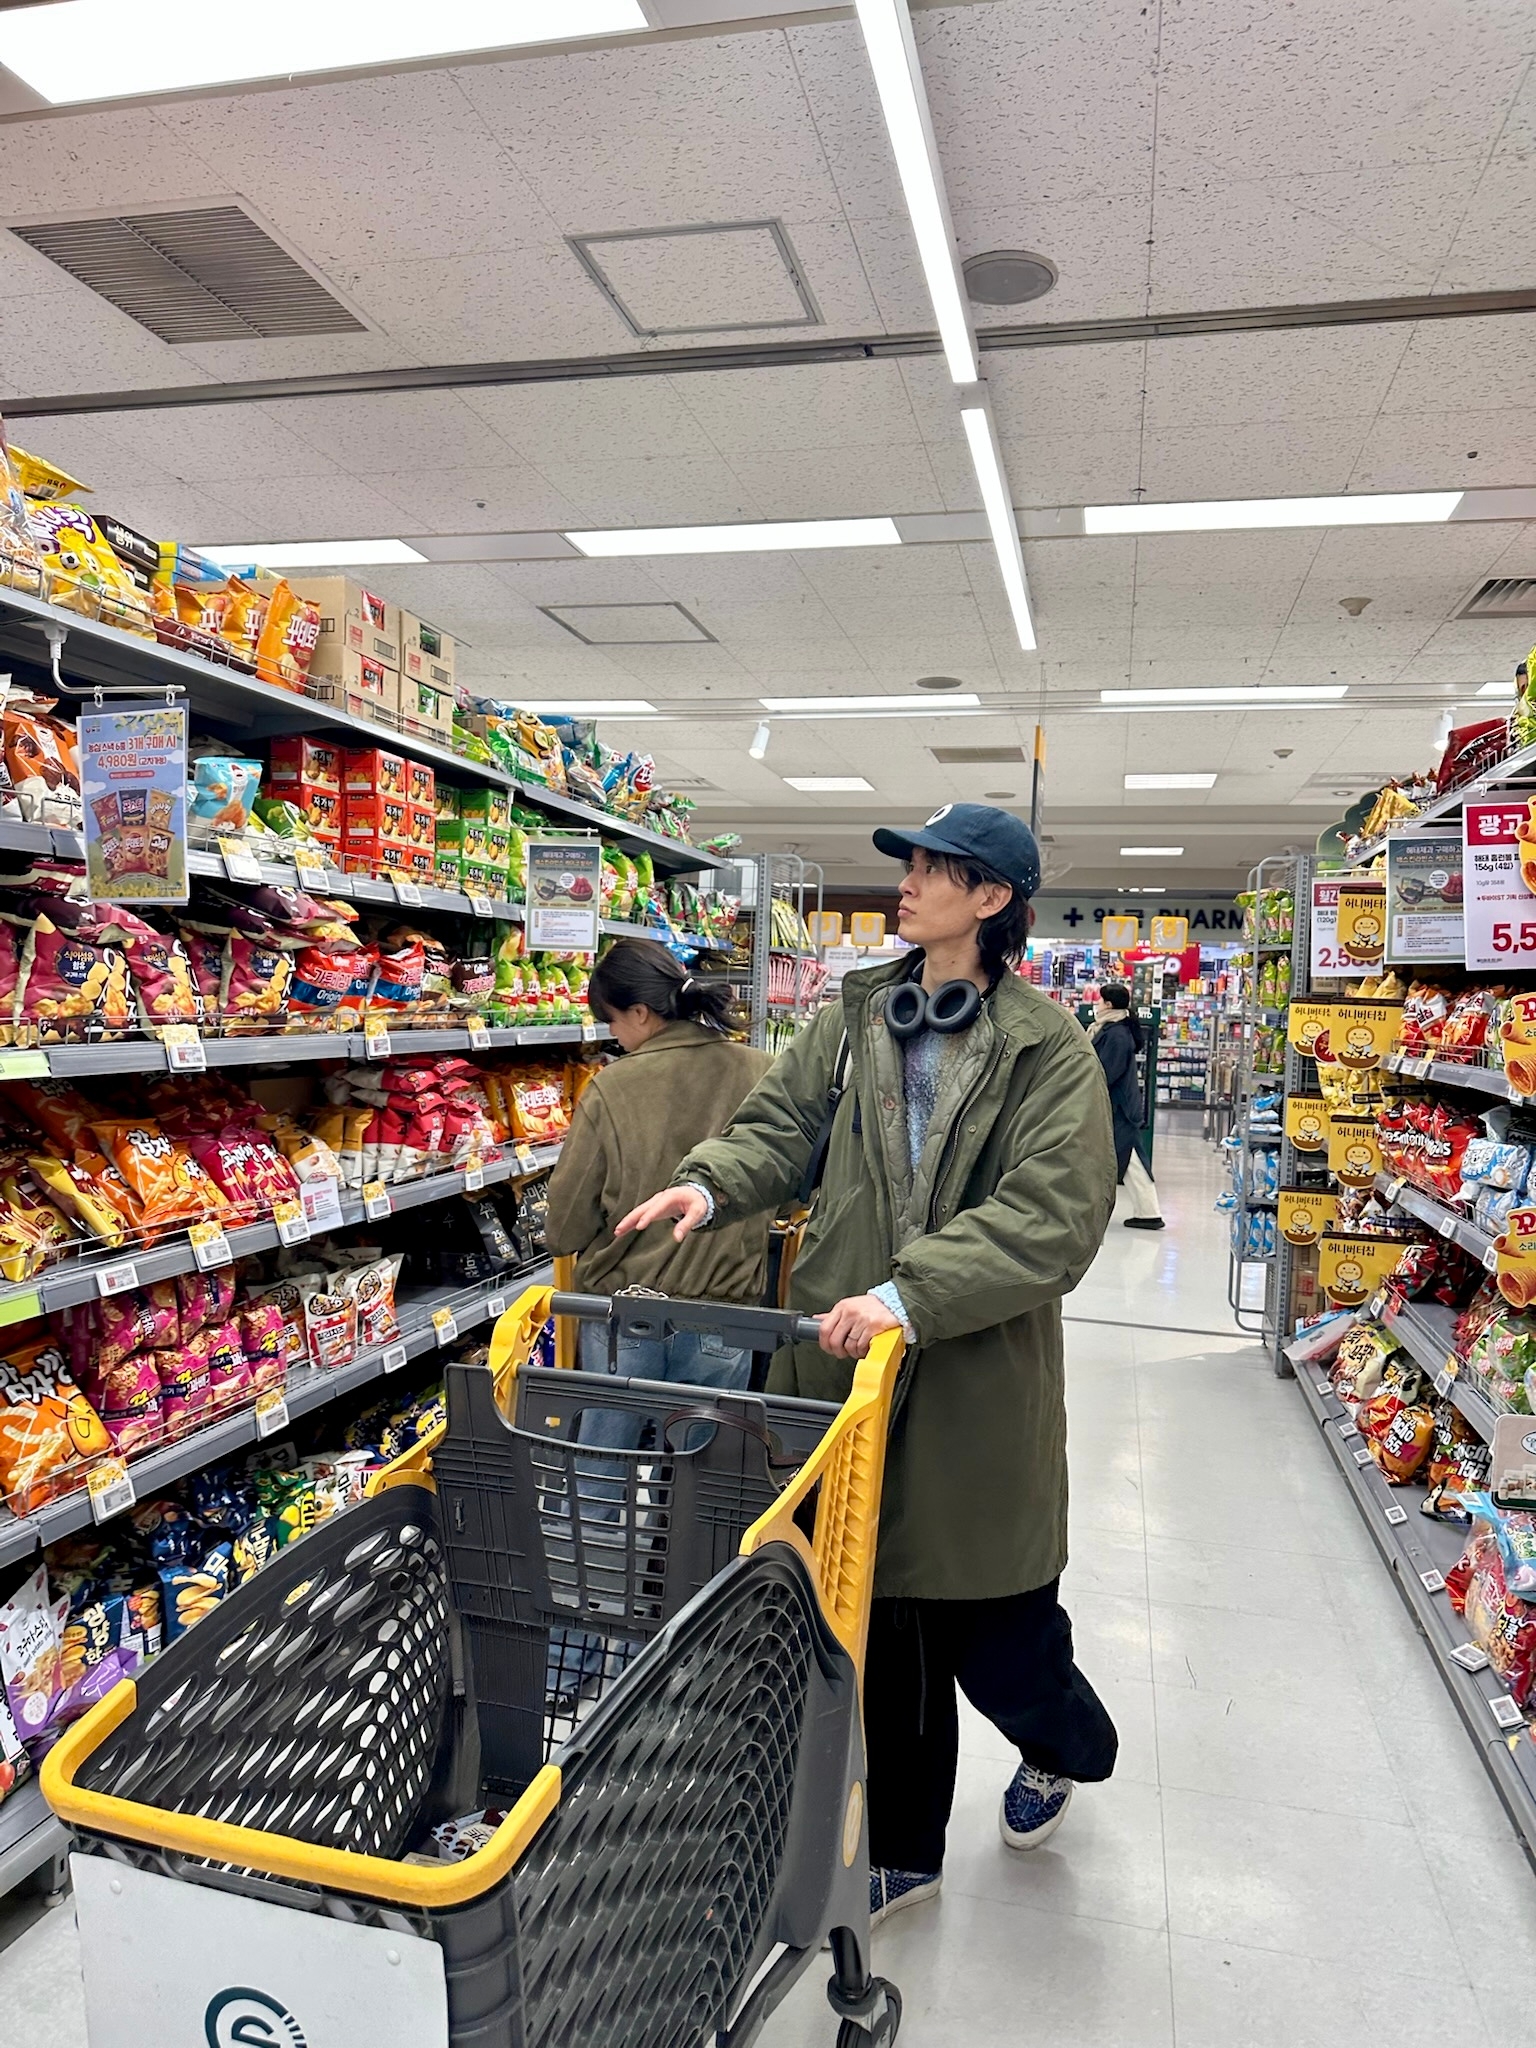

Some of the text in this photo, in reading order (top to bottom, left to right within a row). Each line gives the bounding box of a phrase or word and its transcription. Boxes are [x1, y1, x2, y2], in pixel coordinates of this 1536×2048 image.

[282, 614, 320, 650] 포테토
[128, 737, 144, 750] 3개
[146, 735, 164, 749] 구매
[166, 735, 176, 748] 시
[98, 753, 137, 769] 4,980원
[1474, 862, 1514, 872] 156g (4입)
[1113, 918, 1129, 938] 7
[316, 989, 341, 1003] Origin
[1338, 1008, 1387, 1022] 허니버터칩
[1337, 1126, 1378, 1139] 허니버터
[1284, 1195, 1322, 1206] 허니버터칩
[1328, 1242, 1375, 1257] 허니버터칩
